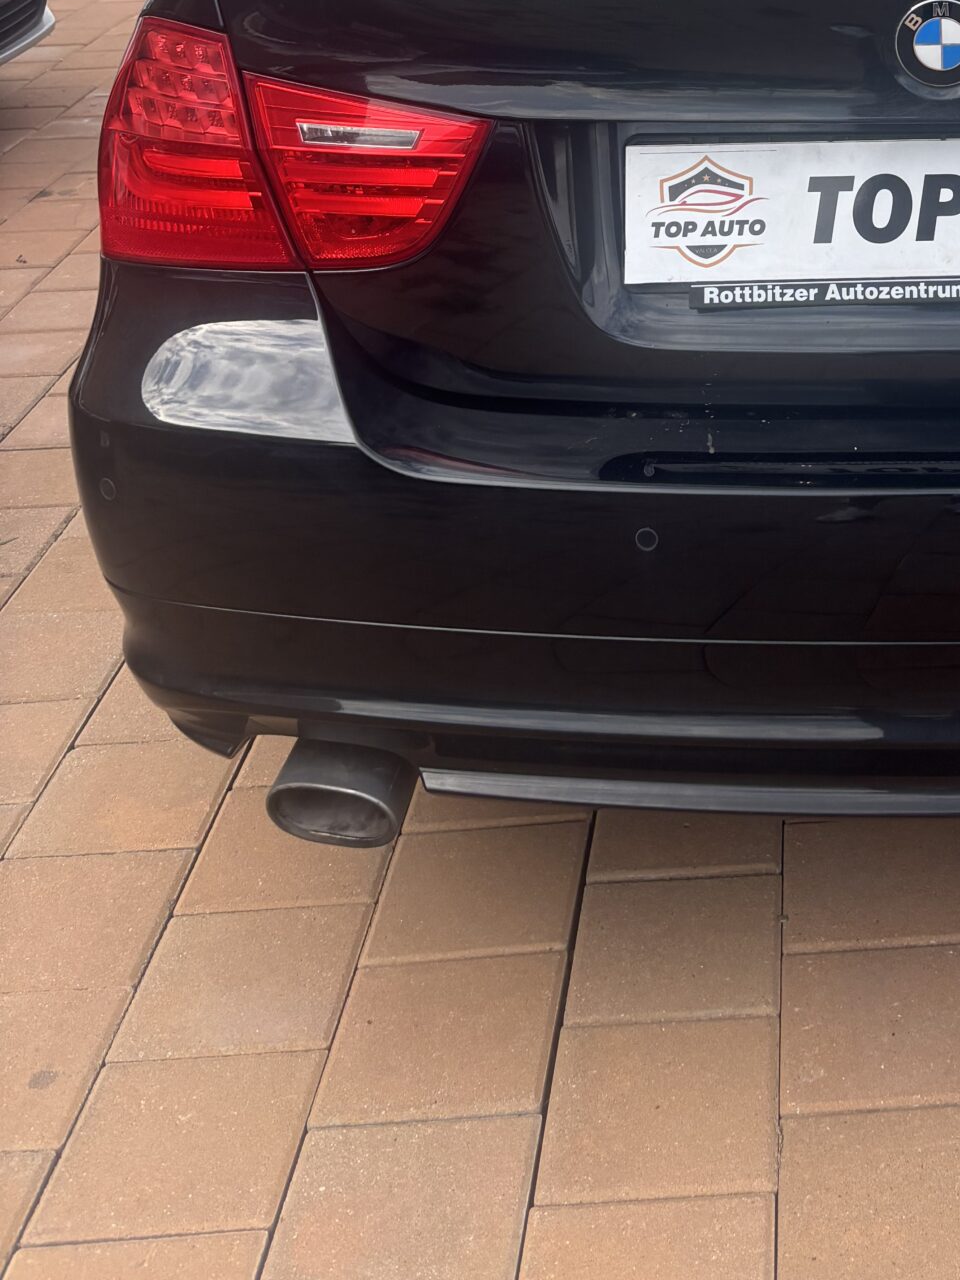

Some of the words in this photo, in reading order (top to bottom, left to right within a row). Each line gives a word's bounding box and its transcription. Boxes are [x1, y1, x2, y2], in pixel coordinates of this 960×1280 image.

[651, 221, 698, 238] TOP
[700, 219, 766, 237] AUTO
[703, 285, 818, 304] Rottbitzer
